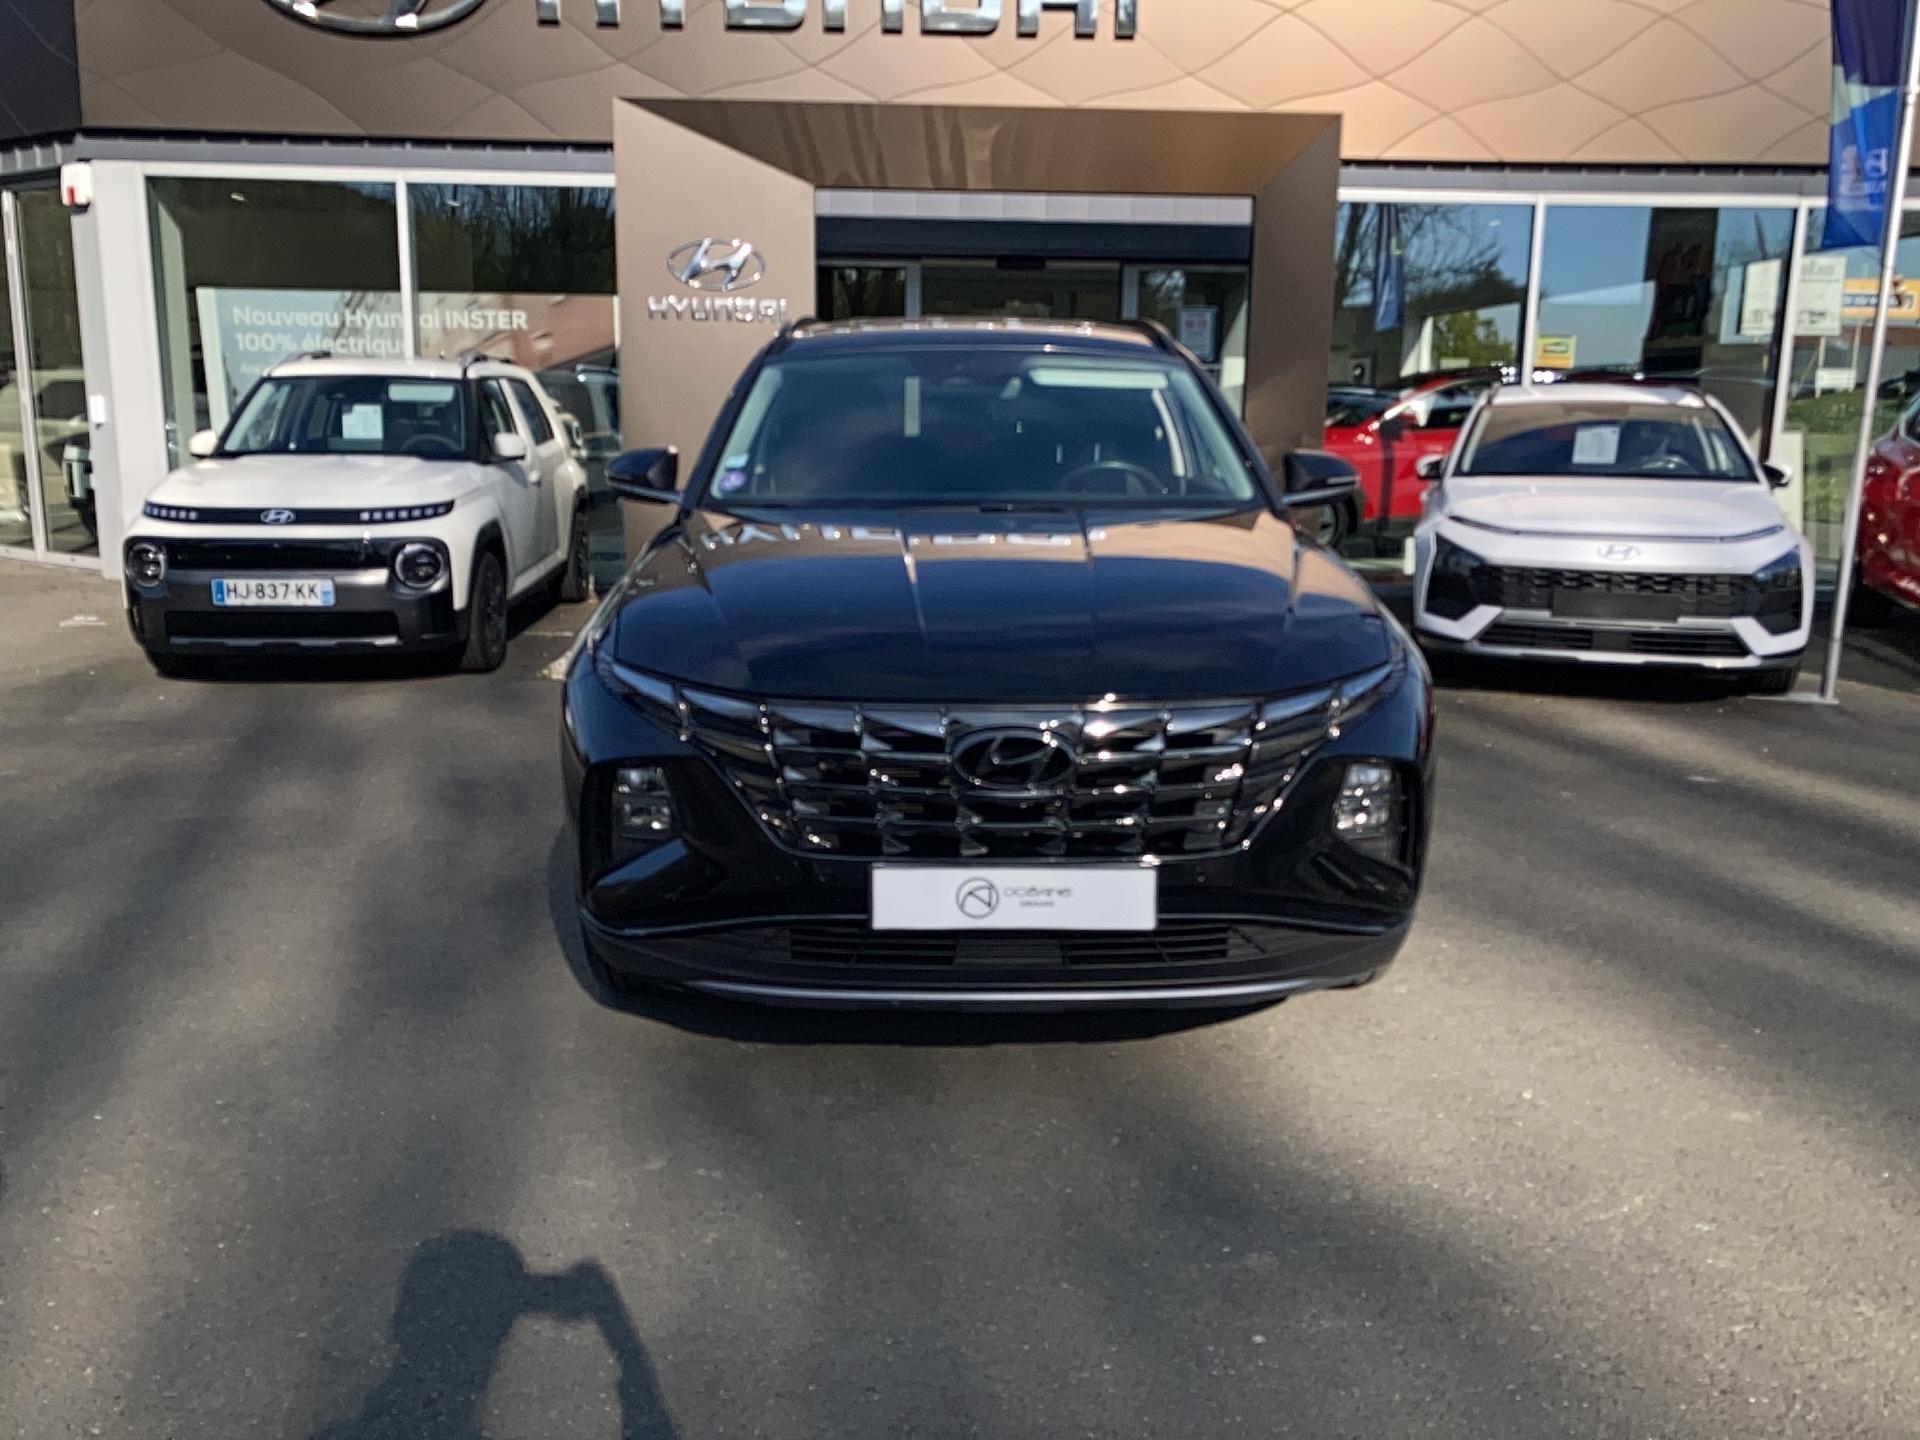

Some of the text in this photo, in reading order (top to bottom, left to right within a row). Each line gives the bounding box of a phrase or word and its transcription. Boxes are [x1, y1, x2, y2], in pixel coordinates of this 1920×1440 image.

[232, 307, 528, 330] Nouveau Hyunai INSTER
[648, 295, 786, 322] HYUNDAI
[234, 332, 296, 351] 100%
